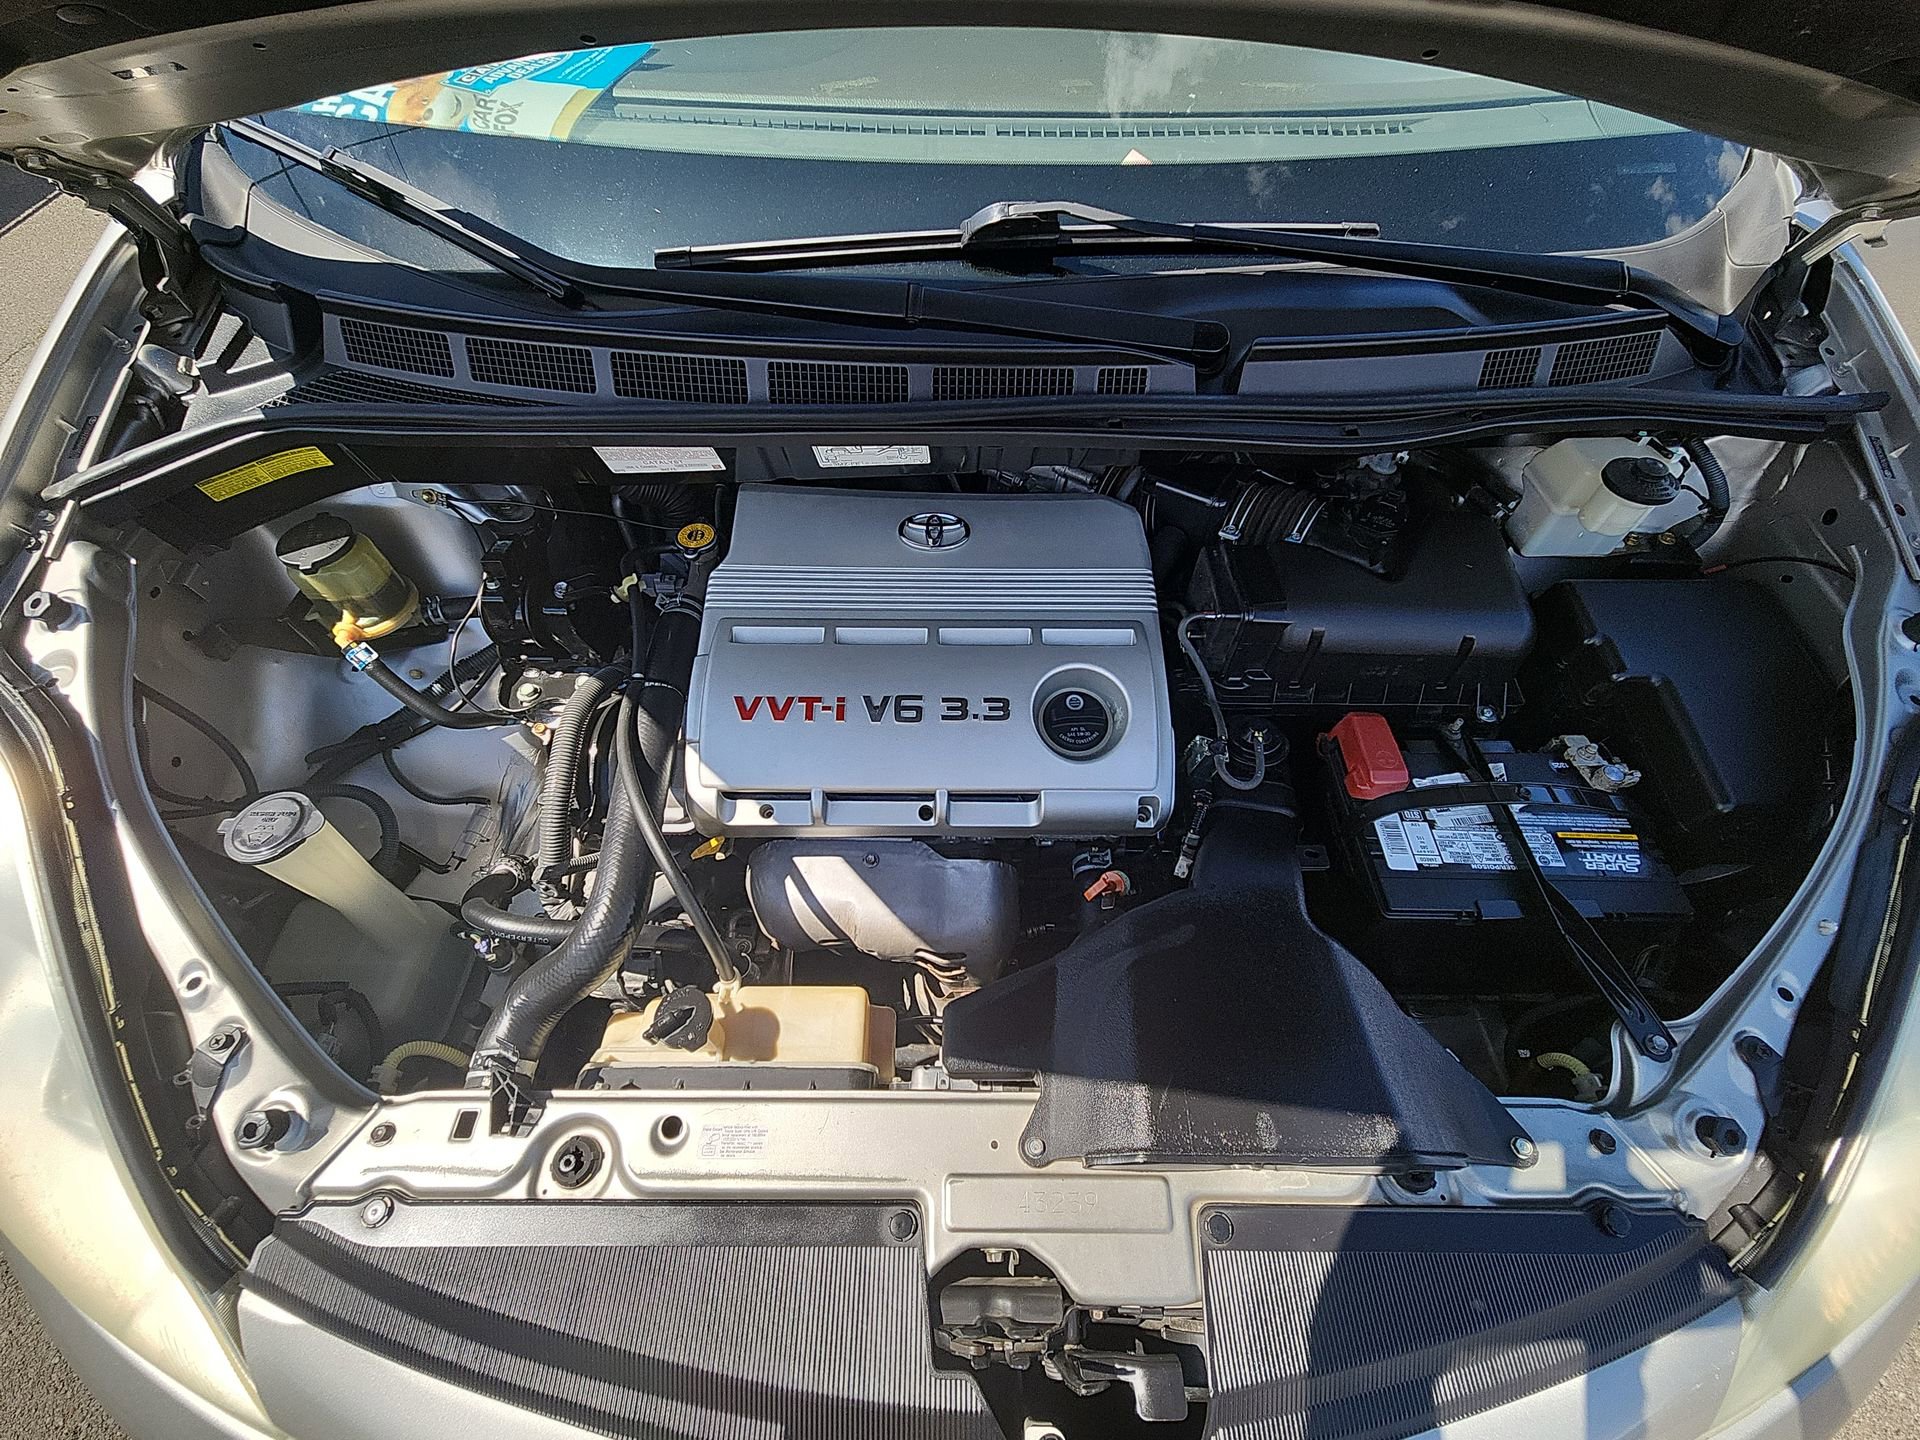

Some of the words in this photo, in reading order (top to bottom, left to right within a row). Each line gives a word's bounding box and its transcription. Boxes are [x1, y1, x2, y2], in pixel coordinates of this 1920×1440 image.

[472, 94, 498, 130] CAR
[493, 101, 525, 133] FOX
[733, 695, 846, 722] VVT-i
[861, 695, 924, 724] V6
[940, 696, 1011, 722] 3.3
[1582, 852, 1641, 866] START
[1585, 861, 1639, 873] SUPER
